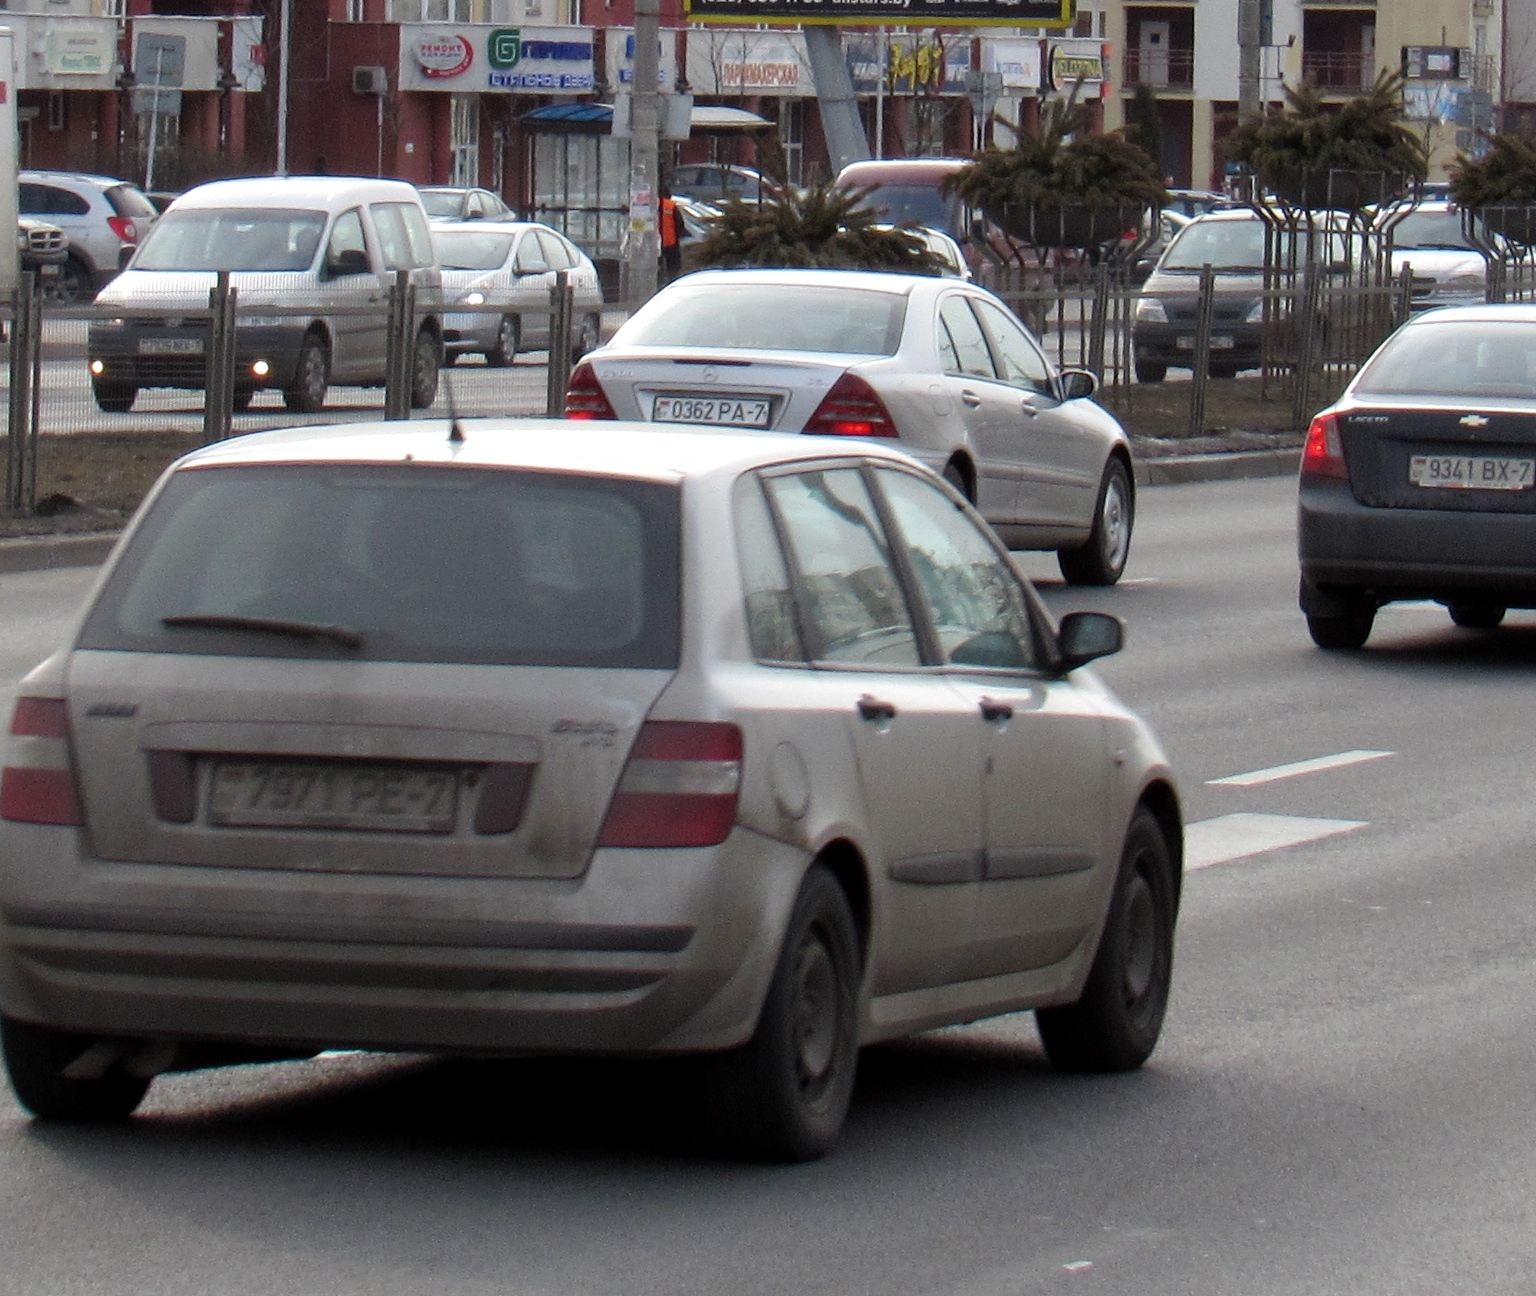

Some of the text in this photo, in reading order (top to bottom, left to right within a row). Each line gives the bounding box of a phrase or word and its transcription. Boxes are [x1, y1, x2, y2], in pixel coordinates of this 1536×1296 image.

[420, 44, 463, 52] РЕМОНТ
[673, 401, 766, 421] 0362 PA-7
[1429, 459, 1531, 482] 9341 BX-7
